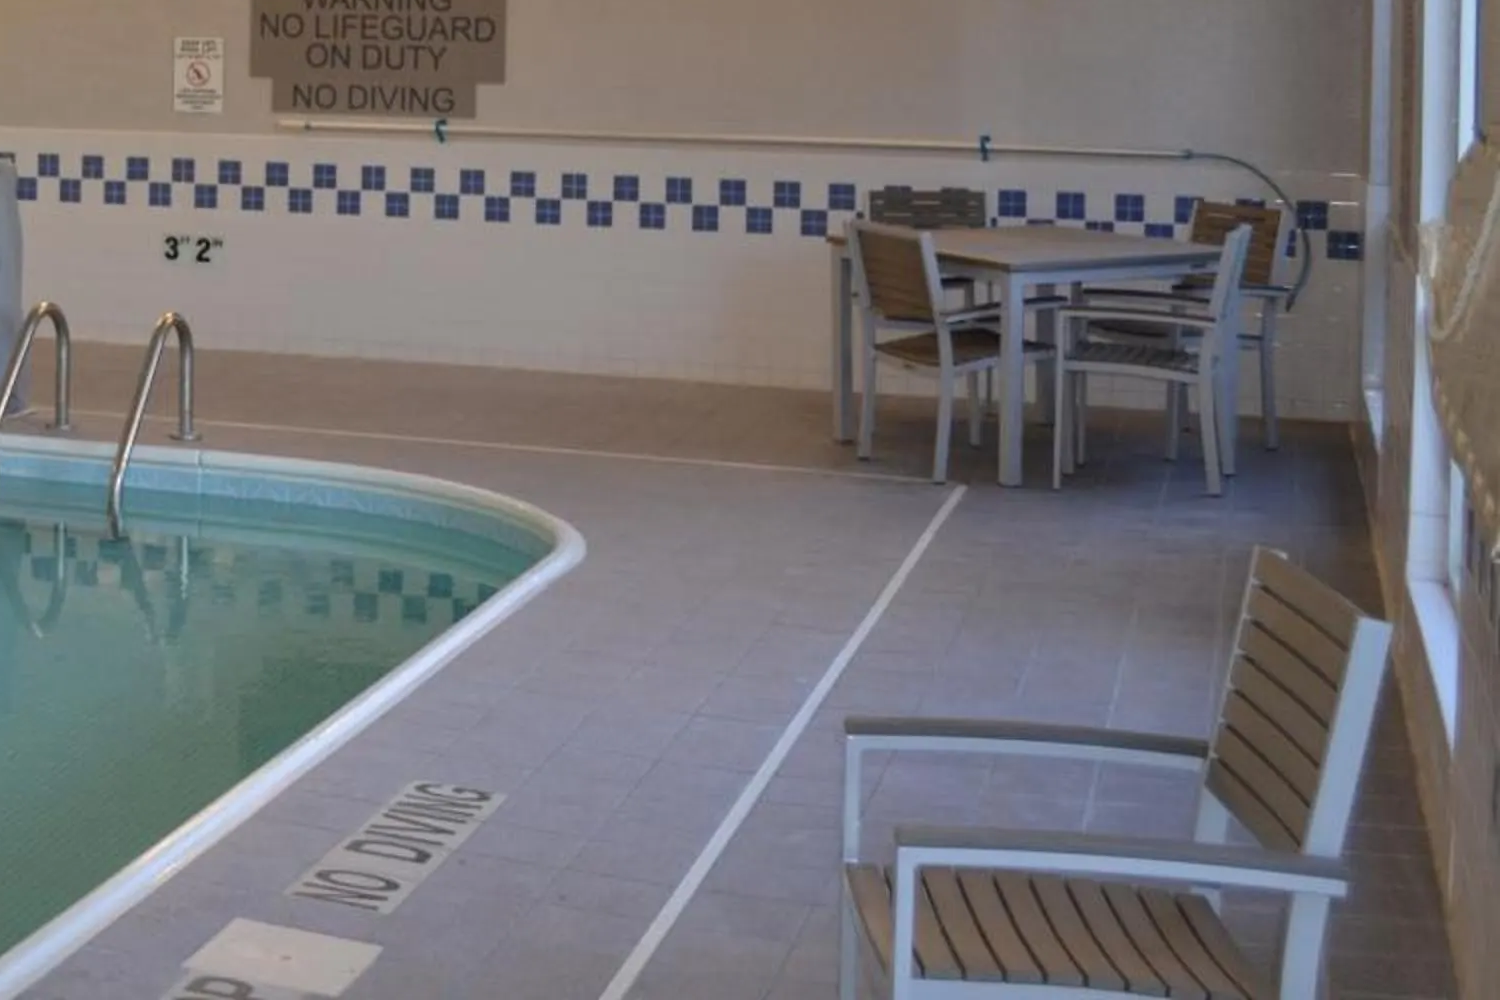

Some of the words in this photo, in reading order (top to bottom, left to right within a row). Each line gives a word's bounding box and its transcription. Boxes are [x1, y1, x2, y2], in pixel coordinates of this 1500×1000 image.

[260, 12, 305, 40] NO
[315, 14, 497, 43] LIFEGUARD
[305, 42, 350, 70] ON
[362, 44, 448, 72] DUTY
[292, 84, 337, 110] NO
[348, 84, 456, 113] DIVING
[345, 782, 493, 864] DIVING
[294, 868, 400, 911] NO
